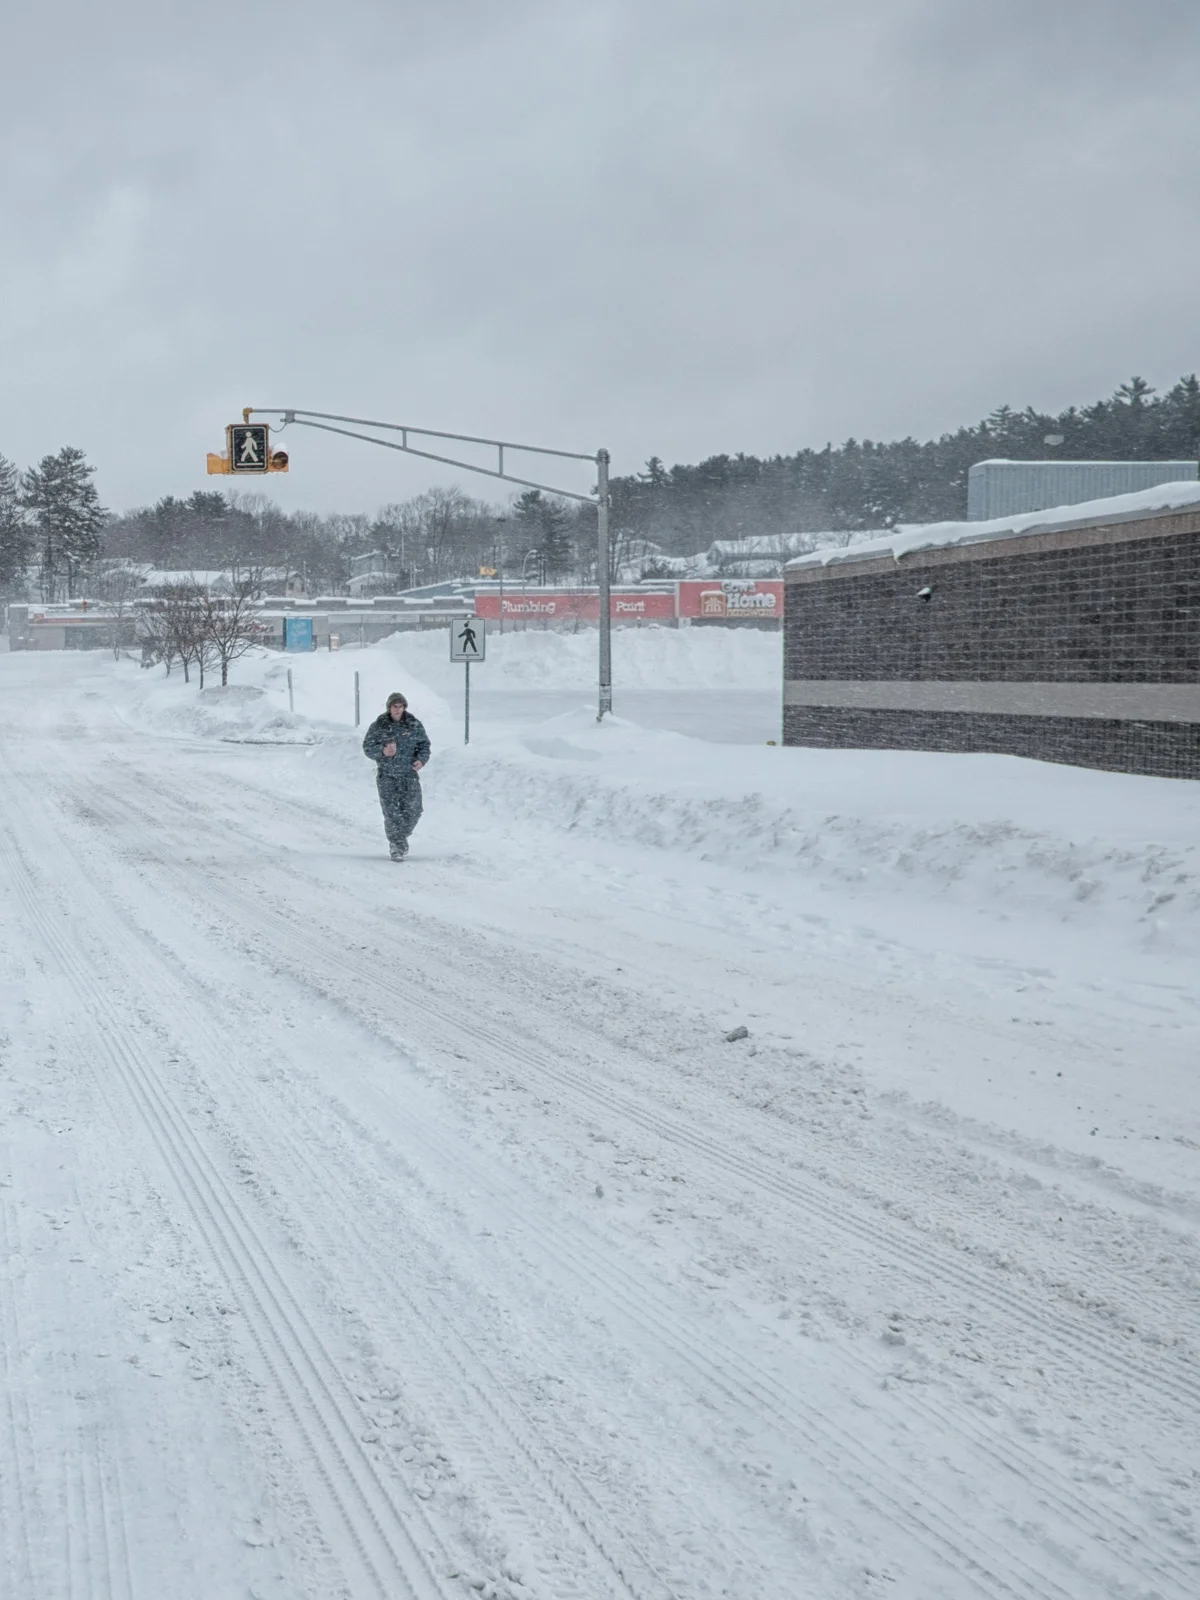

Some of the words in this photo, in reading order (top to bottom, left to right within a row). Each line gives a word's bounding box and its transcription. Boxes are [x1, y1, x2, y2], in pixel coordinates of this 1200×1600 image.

[501, 599, 556, 614] Plumbing
[615, 600, 646, 612] Paint
[726, 592, 777, 609] Home
